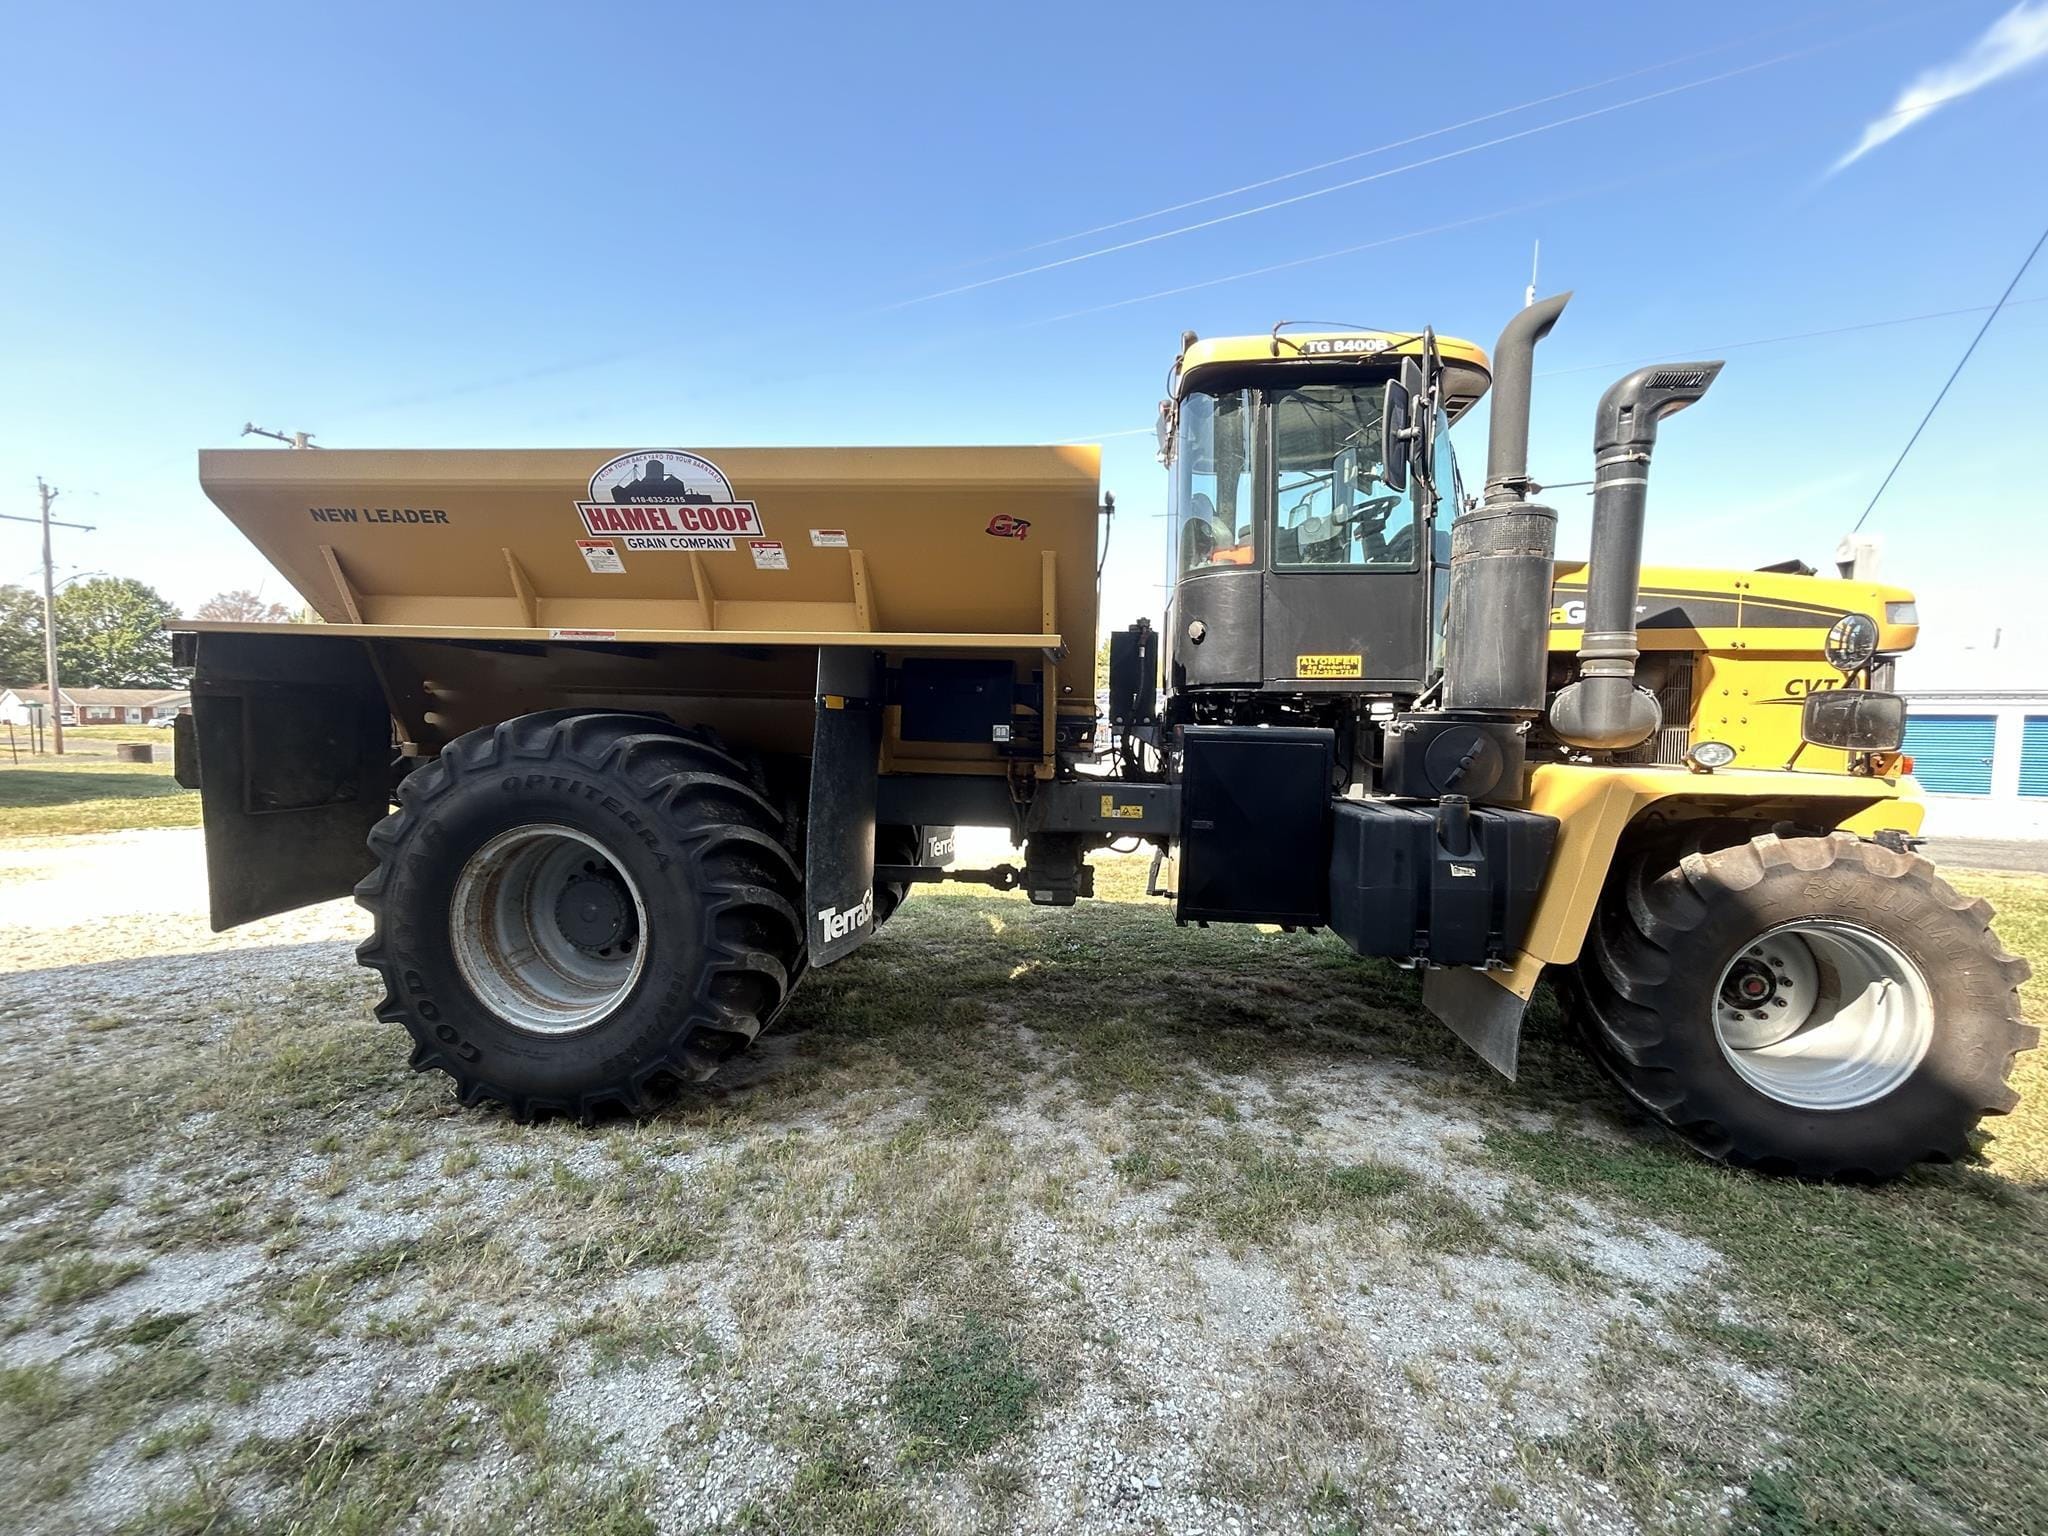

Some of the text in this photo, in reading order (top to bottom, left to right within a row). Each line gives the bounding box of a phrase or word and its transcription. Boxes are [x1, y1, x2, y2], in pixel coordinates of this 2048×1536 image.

[1308, 340, 1331, 353] TG
[598, 466, 614, 481] FROM
[614, 459, 631, 470] YOUR
[675, 455, 692, 464] YOUR
[692, 460, 722, 484] BARNYARD
[309, 508, 450, 524] NEW LEADER
[585, 507, 752, 531] HAMEL COOP
[628, 537, 731, 549] GRAIN COMPANY
[1300, 657, 1358, 665] ALTORFER
[501, 774, 670, 873] OPTITERRA
